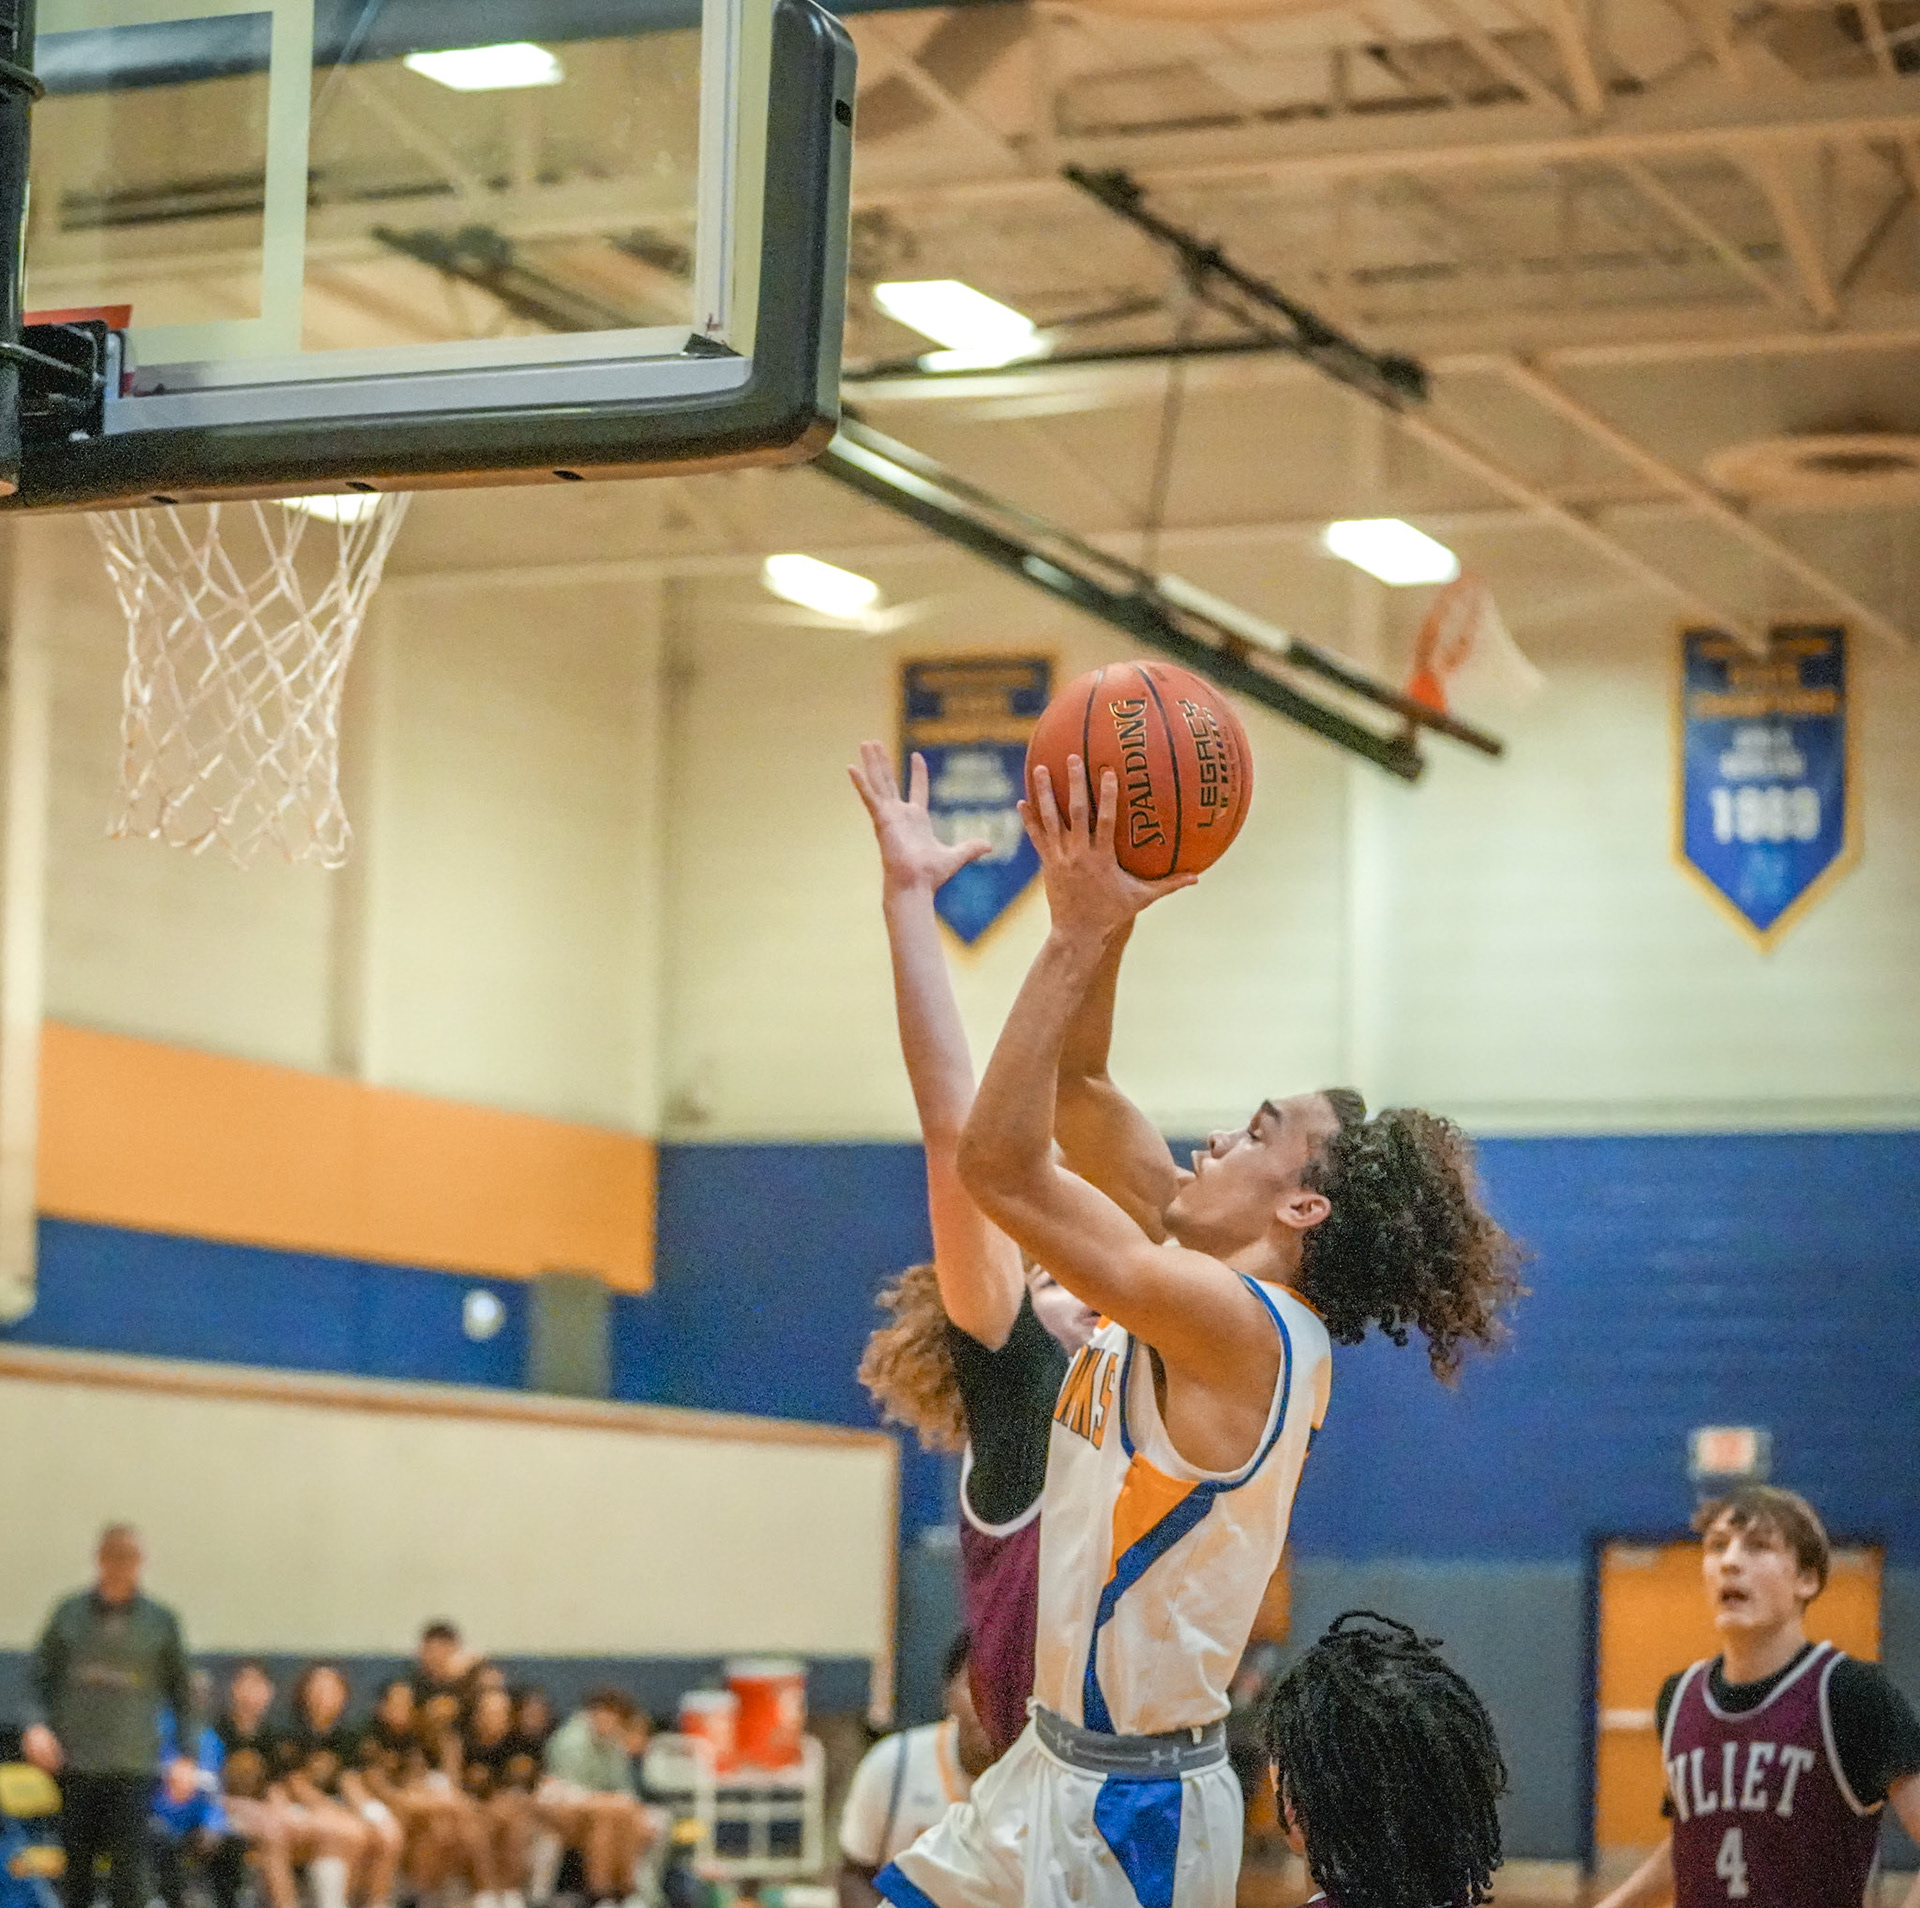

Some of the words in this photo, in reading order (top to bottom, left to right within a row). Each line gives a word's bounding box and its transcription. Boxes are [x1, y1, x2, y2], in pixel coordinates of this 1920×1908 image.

[1108, 697, 1166, 851] SPALDING
[1176, 697, 1219, 829] LEGACY
[1715, 1827, 1750, 1899] 4
